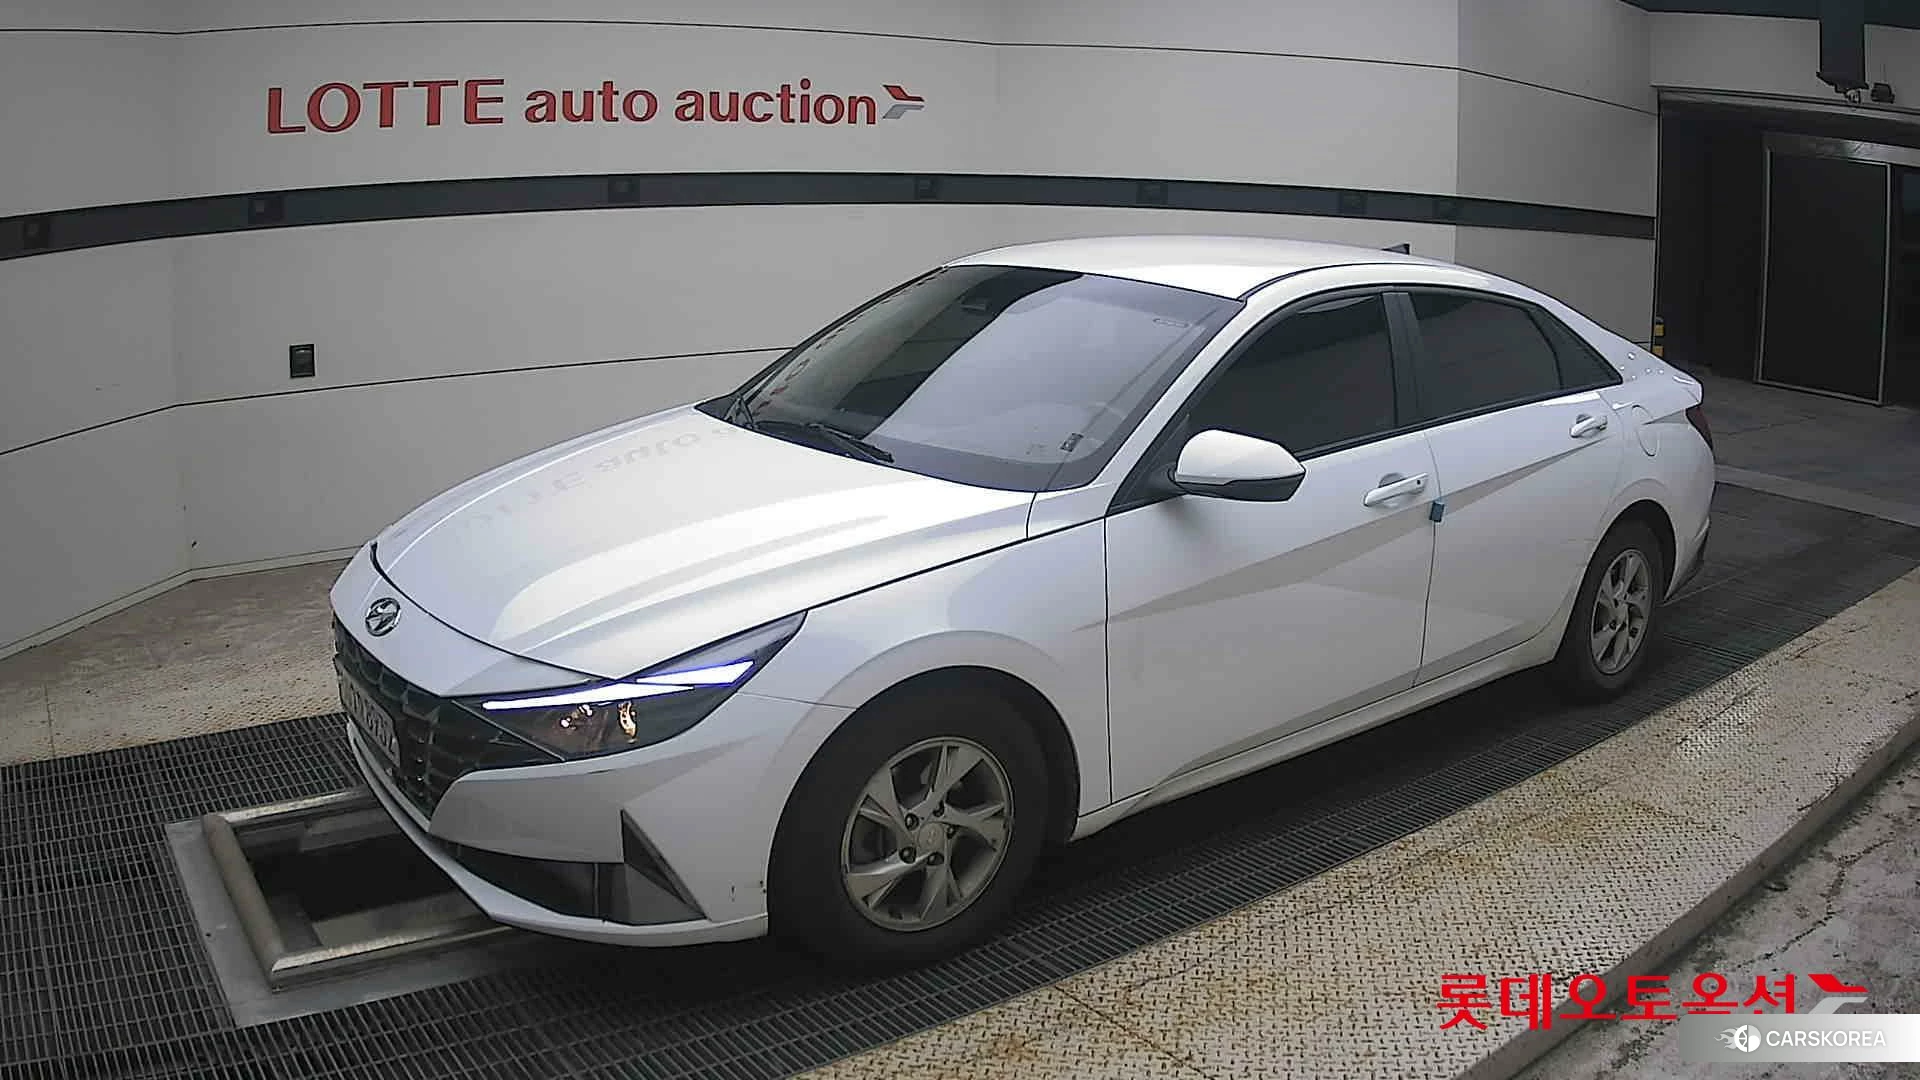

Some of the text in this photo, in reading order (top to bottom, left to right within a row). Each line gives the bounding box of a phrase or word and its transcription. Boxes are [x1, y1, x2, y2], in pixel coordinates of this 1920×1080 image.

[267, 79, 879, 134] LOTTE auto auction
